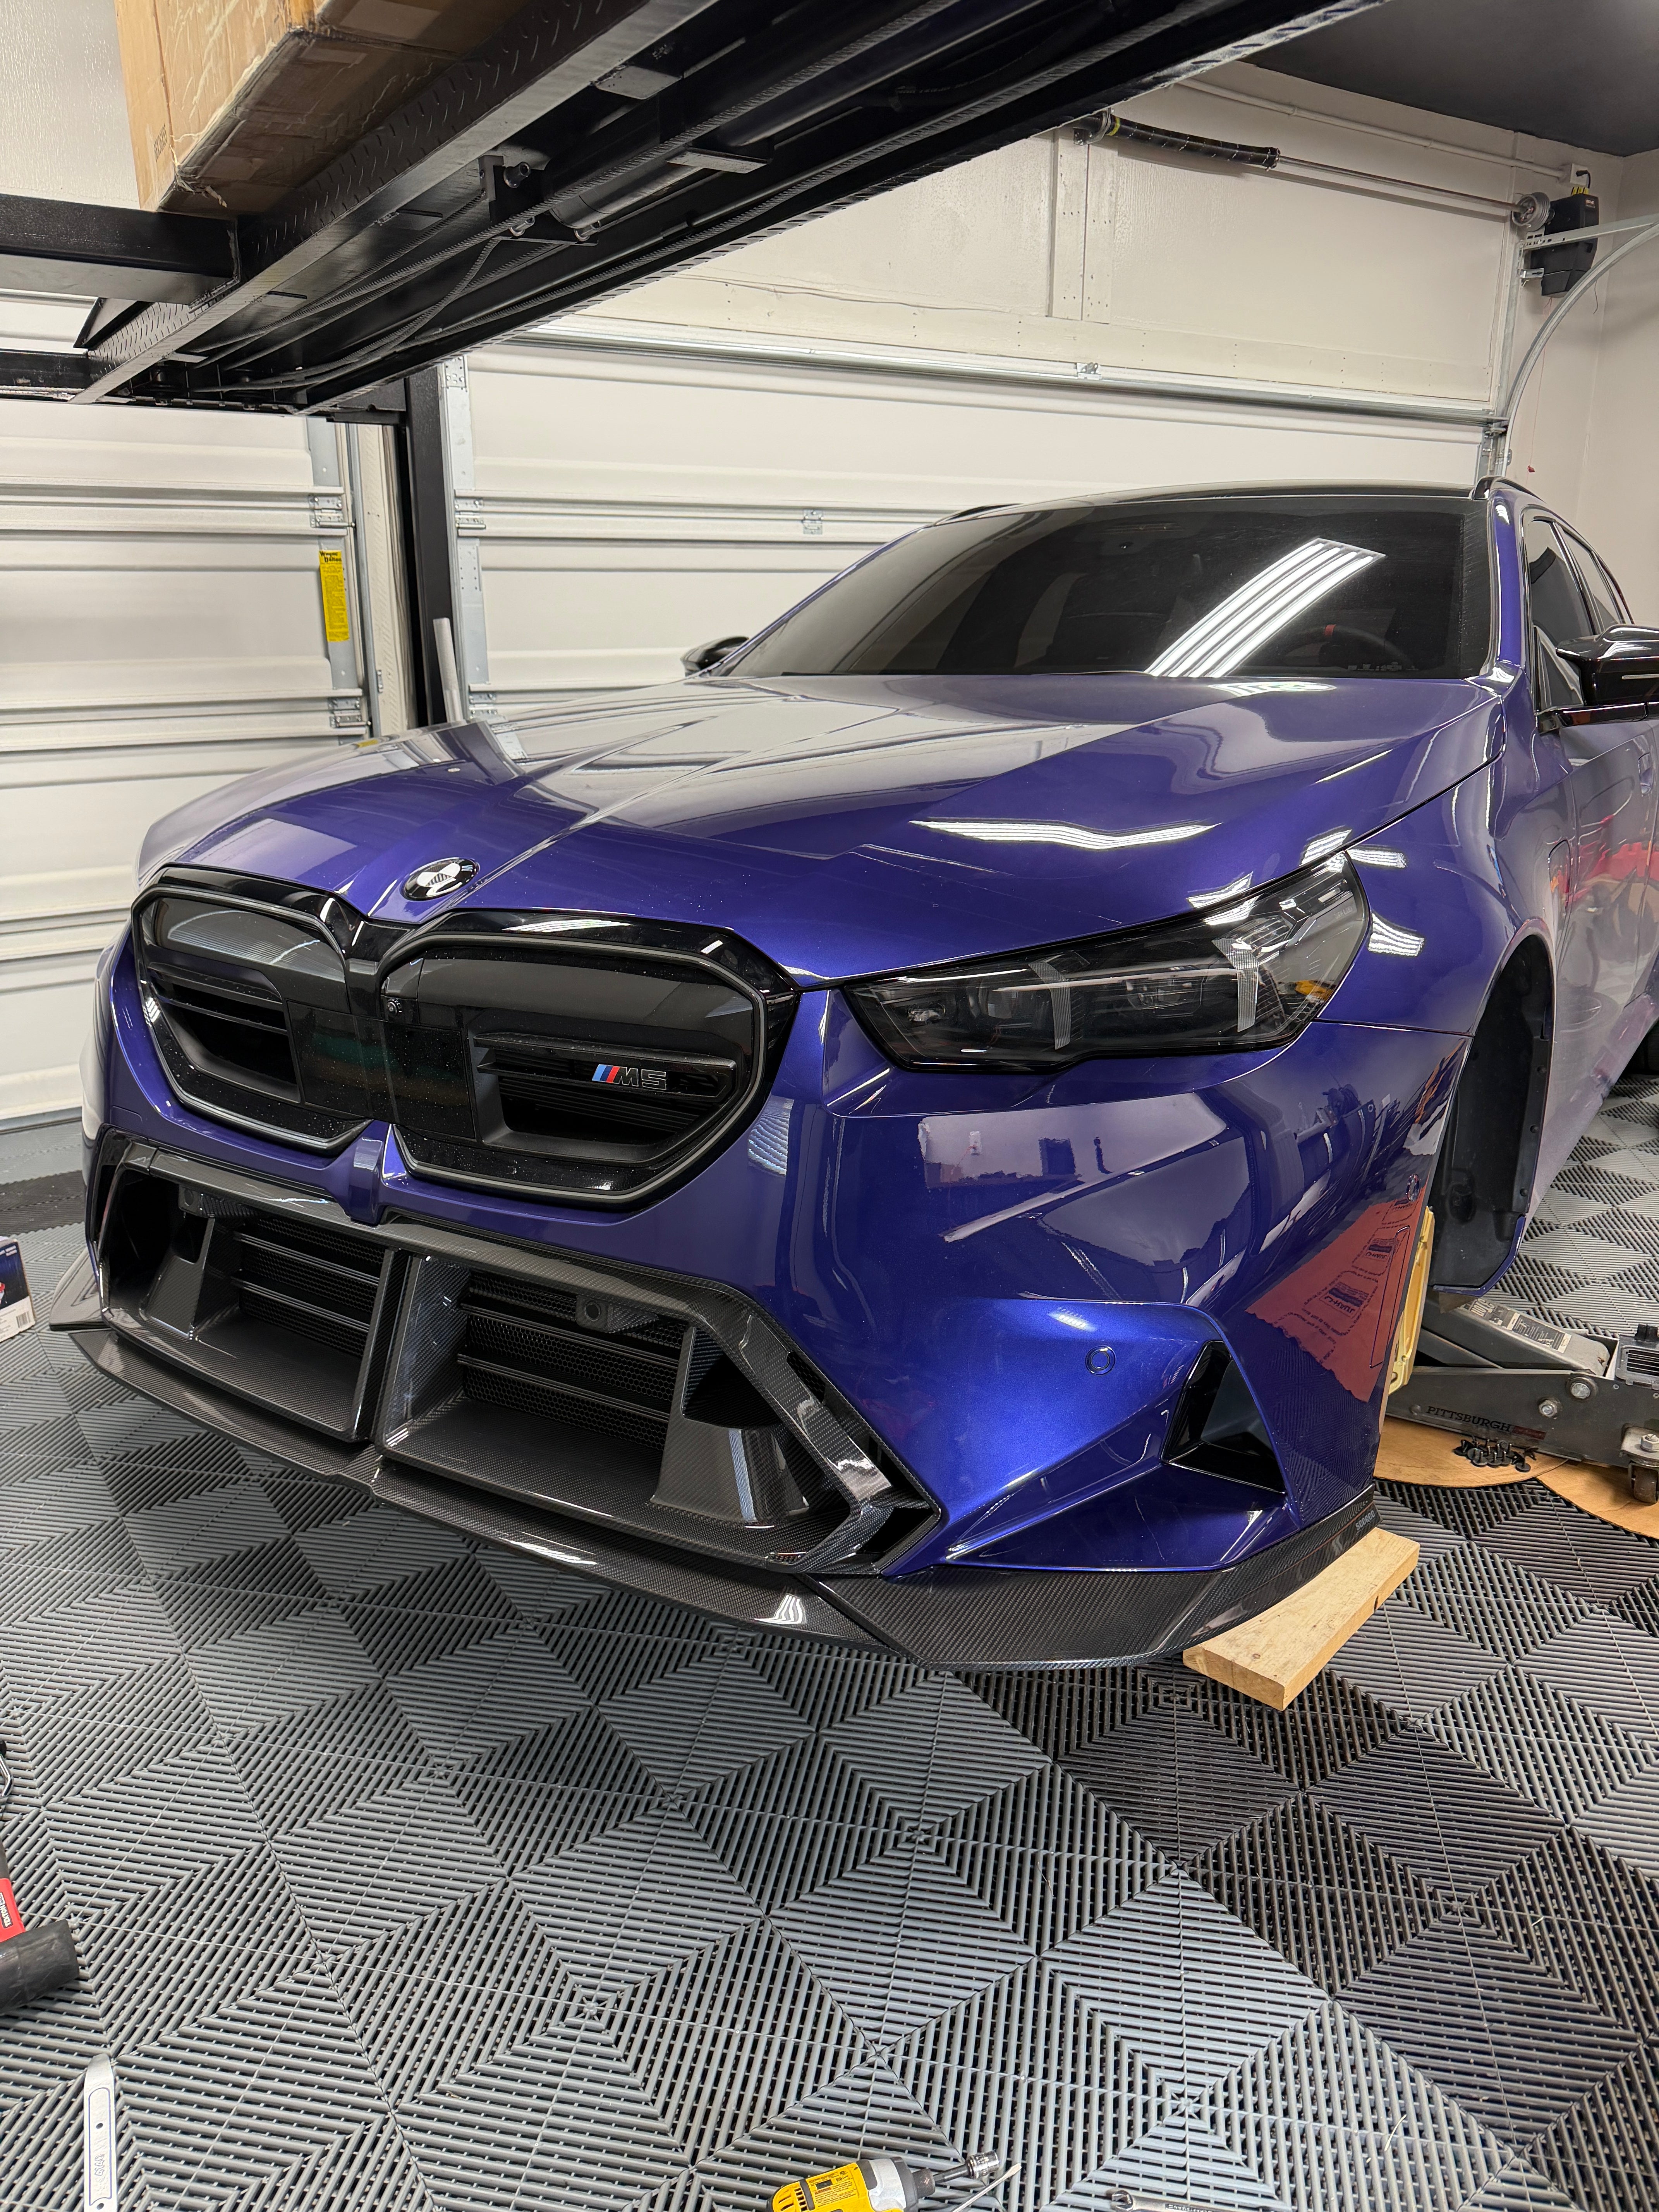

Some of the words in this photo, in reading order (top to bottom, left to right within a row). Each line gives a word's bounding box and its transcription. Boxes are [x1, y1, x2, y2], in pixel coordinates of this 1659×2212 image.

[613, 1067, 667, 1090] M5
[1426, 1406, 1512, 1432] PITTSBURGH
[0, 1905, 11, 1927] TEKTON
